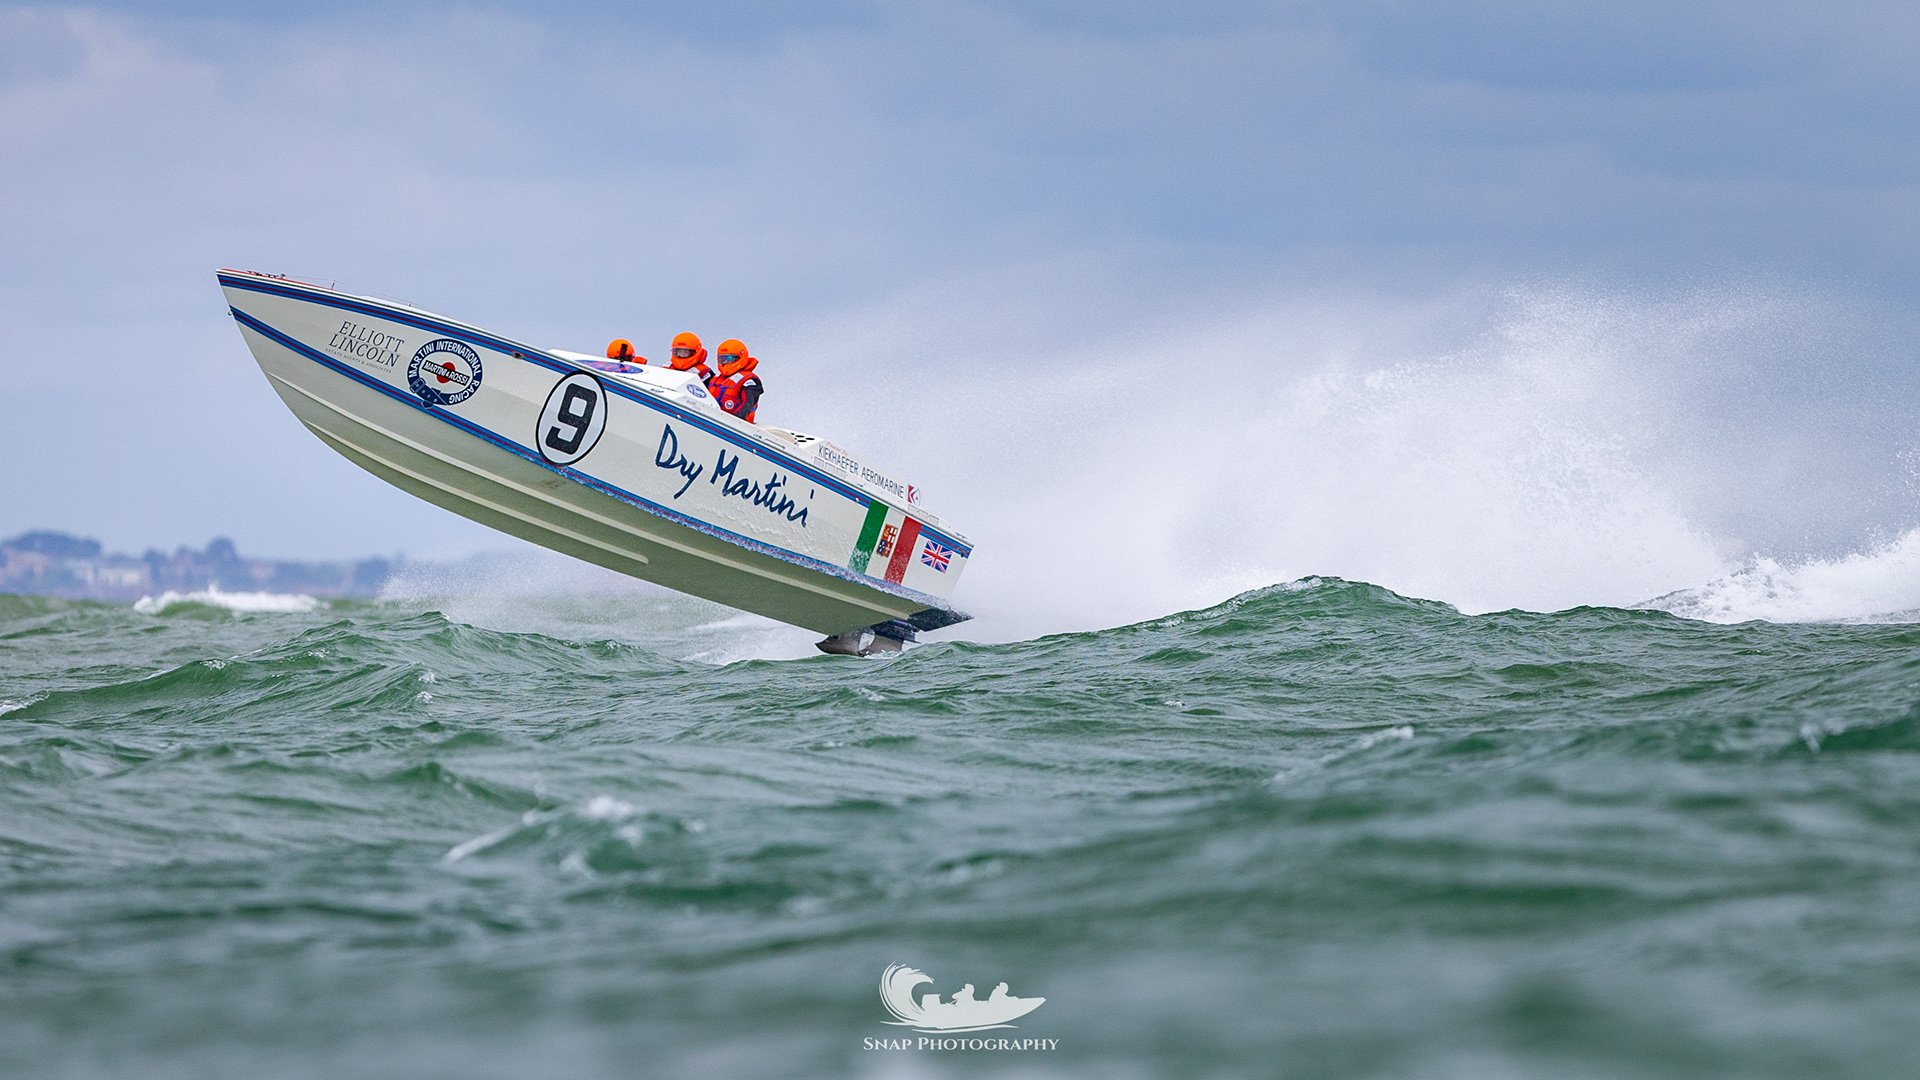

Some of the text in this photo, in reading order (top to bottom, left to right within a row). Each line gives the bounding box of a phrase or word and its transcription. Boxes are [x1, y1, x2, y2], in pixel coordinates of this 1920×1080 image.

[328, 333, 401, 368] LINCOLN
[338, 320, 405, 353] ELLIOTT
[408, 340, 482, 404] MARTINI INTERNATIONAL RACING
[423, 361, 447, 377] MARTINI
[448, 372, 469, 386] ROSSI
[545, 382, 598, 456] 9
[655, 423, 815, 528] Dry Martini
[818, 444, 905, 500] KIEKHAEFER AEROMARINE
